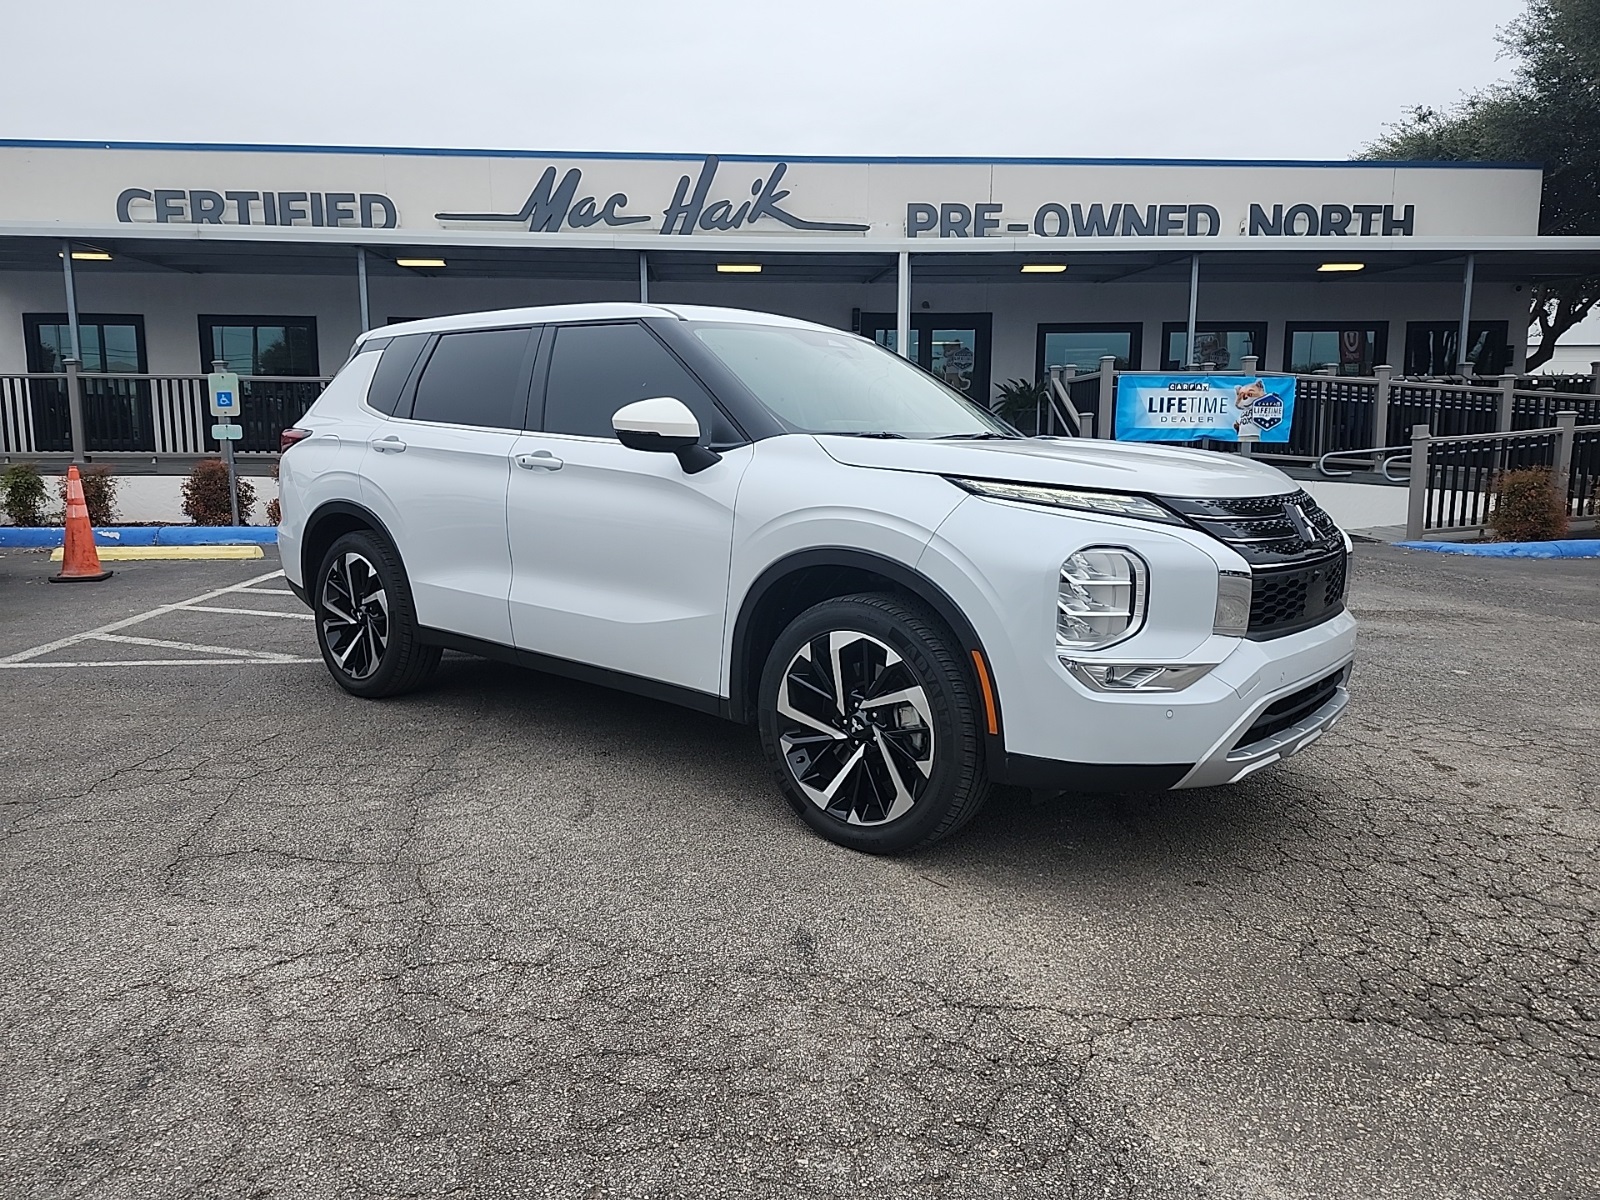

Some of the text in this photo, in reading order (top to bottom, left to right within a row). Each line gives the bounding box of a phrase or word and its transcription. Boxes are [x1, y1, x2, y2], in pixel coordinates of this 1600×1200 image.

[116, 187, 398, 229] CERTIFIED
[434, 154, 871, 236] Mac Haik
[906, 203, 1416, 237] PRE-OWNED NORTH
[1168, 382, 1210, 391] CARFAX
[1147, 397, 1229, 413] LIFETIME
